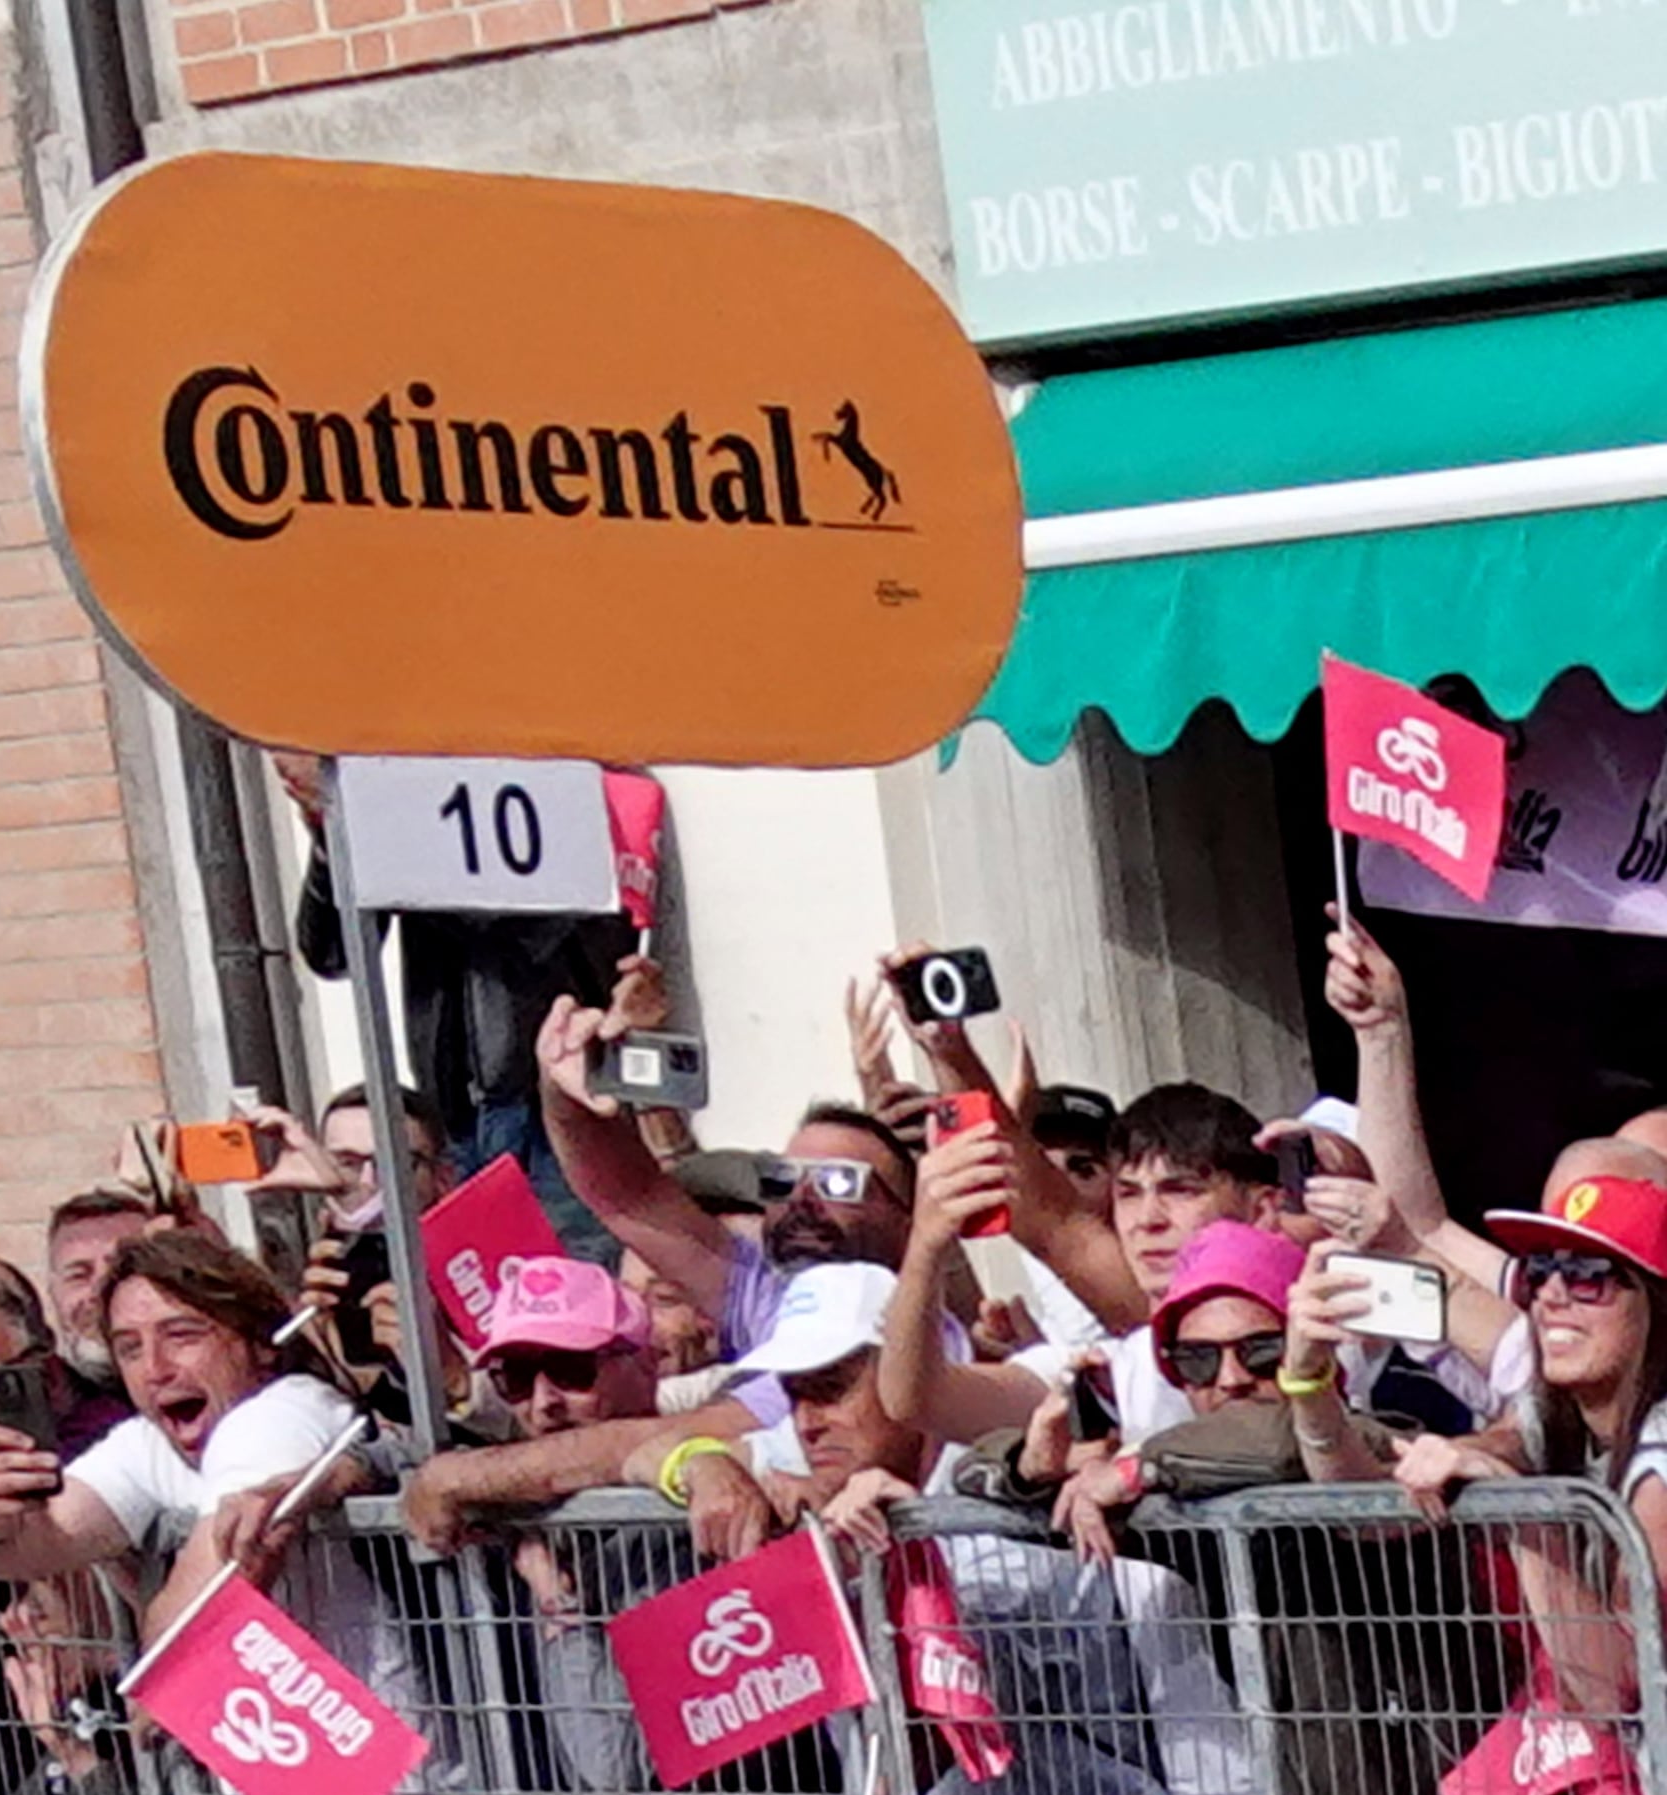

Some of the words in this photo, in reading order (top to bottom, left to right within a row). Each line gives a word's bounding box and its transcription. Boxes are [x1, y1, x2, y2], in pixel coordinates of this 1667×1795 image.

[971, 176, 1149, 277] BORSE
[1188, 137, 1410, 245] SCARPE
[1451, 97, 1667, 211] BIGIOT
[164, 364, 812, 541] Continental
[441, 783, 542, 876] 10
